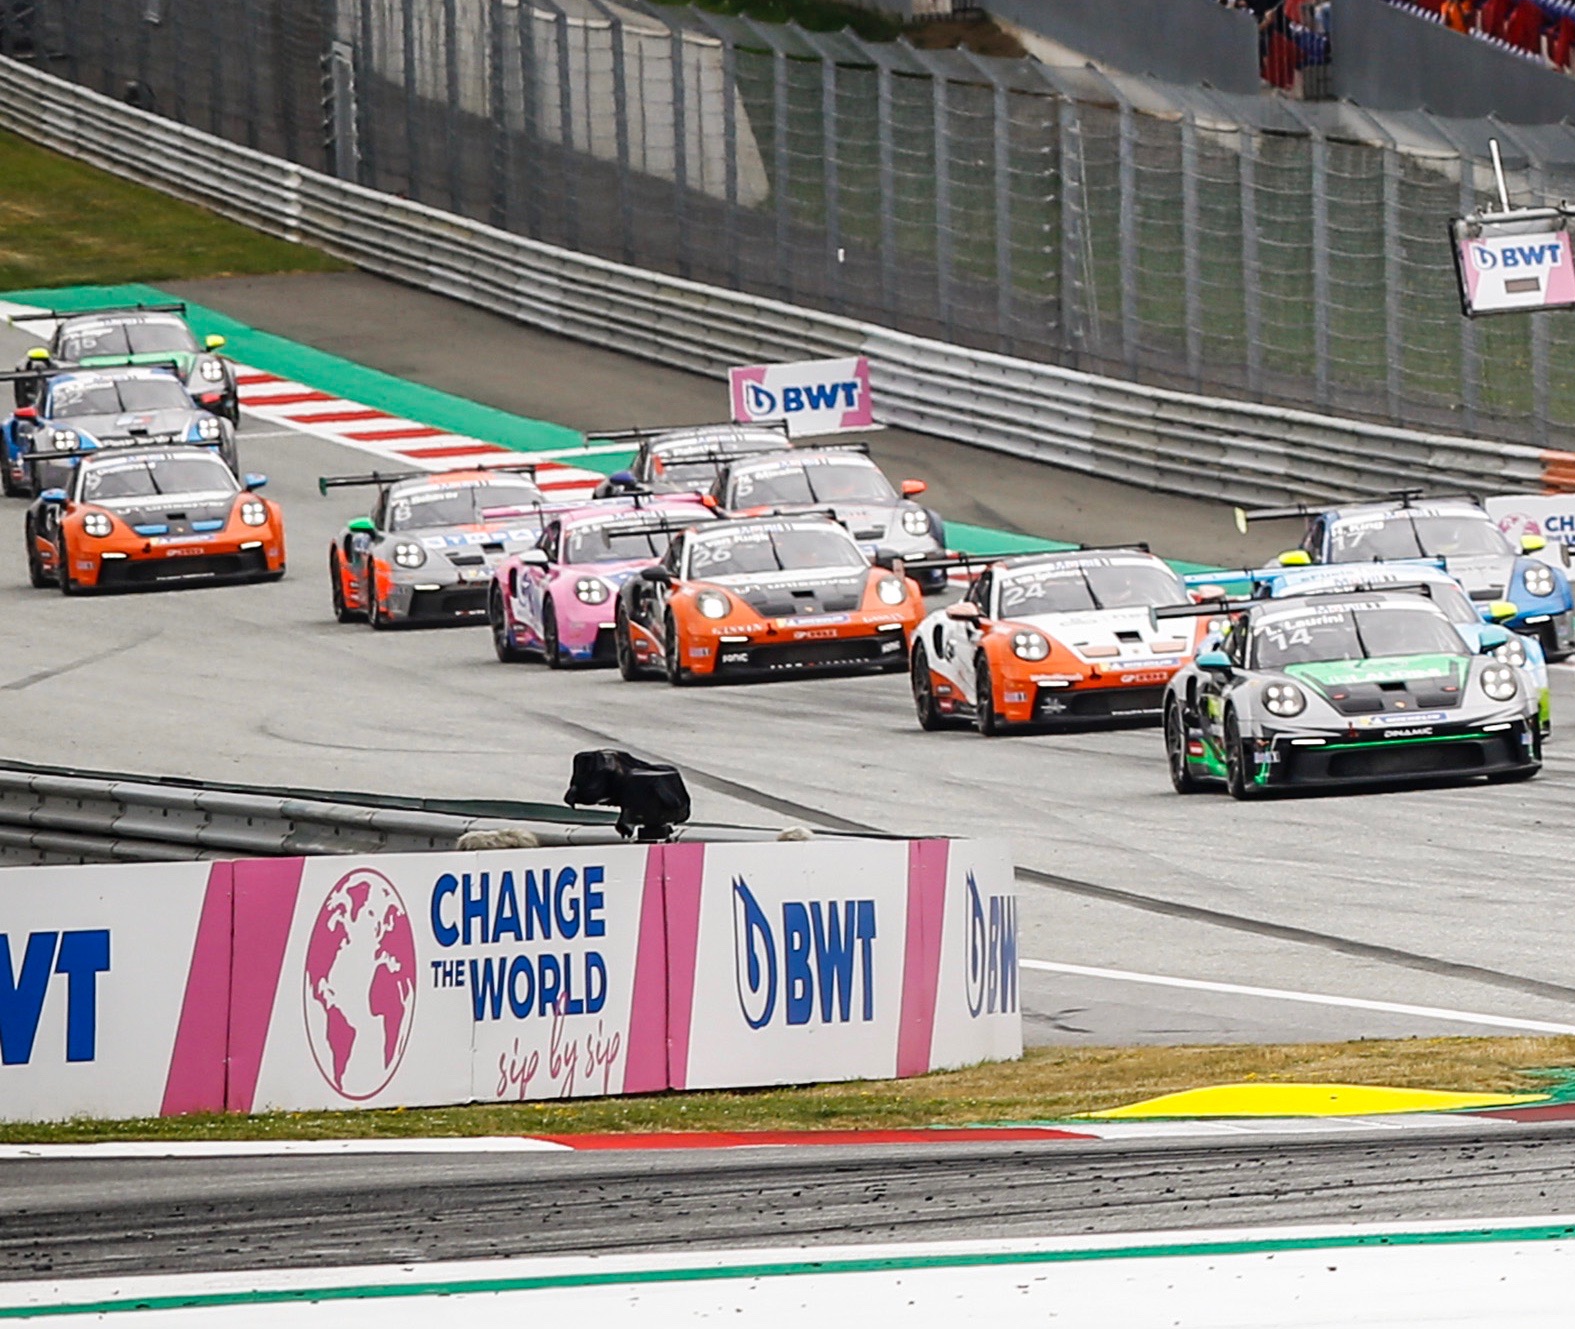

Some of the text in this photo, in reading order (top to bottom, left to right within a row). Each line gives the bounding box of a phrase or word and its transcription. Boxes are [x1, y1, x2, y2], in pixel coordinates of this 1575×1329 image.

[1501, 243, 1561, 268] BWT
[783, 381, 859, 413] BWT
[1332, 532, 1366, 551] 17
[692, 547, 732, 568] 26
[1004, 583, 1046, 607] 24
[1269, 629, 1313, 650] 14
[1384, 727, 1433, 738] DINAMIC
[430, 865, 606, 948] CHANGE
[781, 899, 877, 1026] BWT
[430, 951, 608, 1023] THE WORLD
[497, 990, 621, 1101] sip by sip
